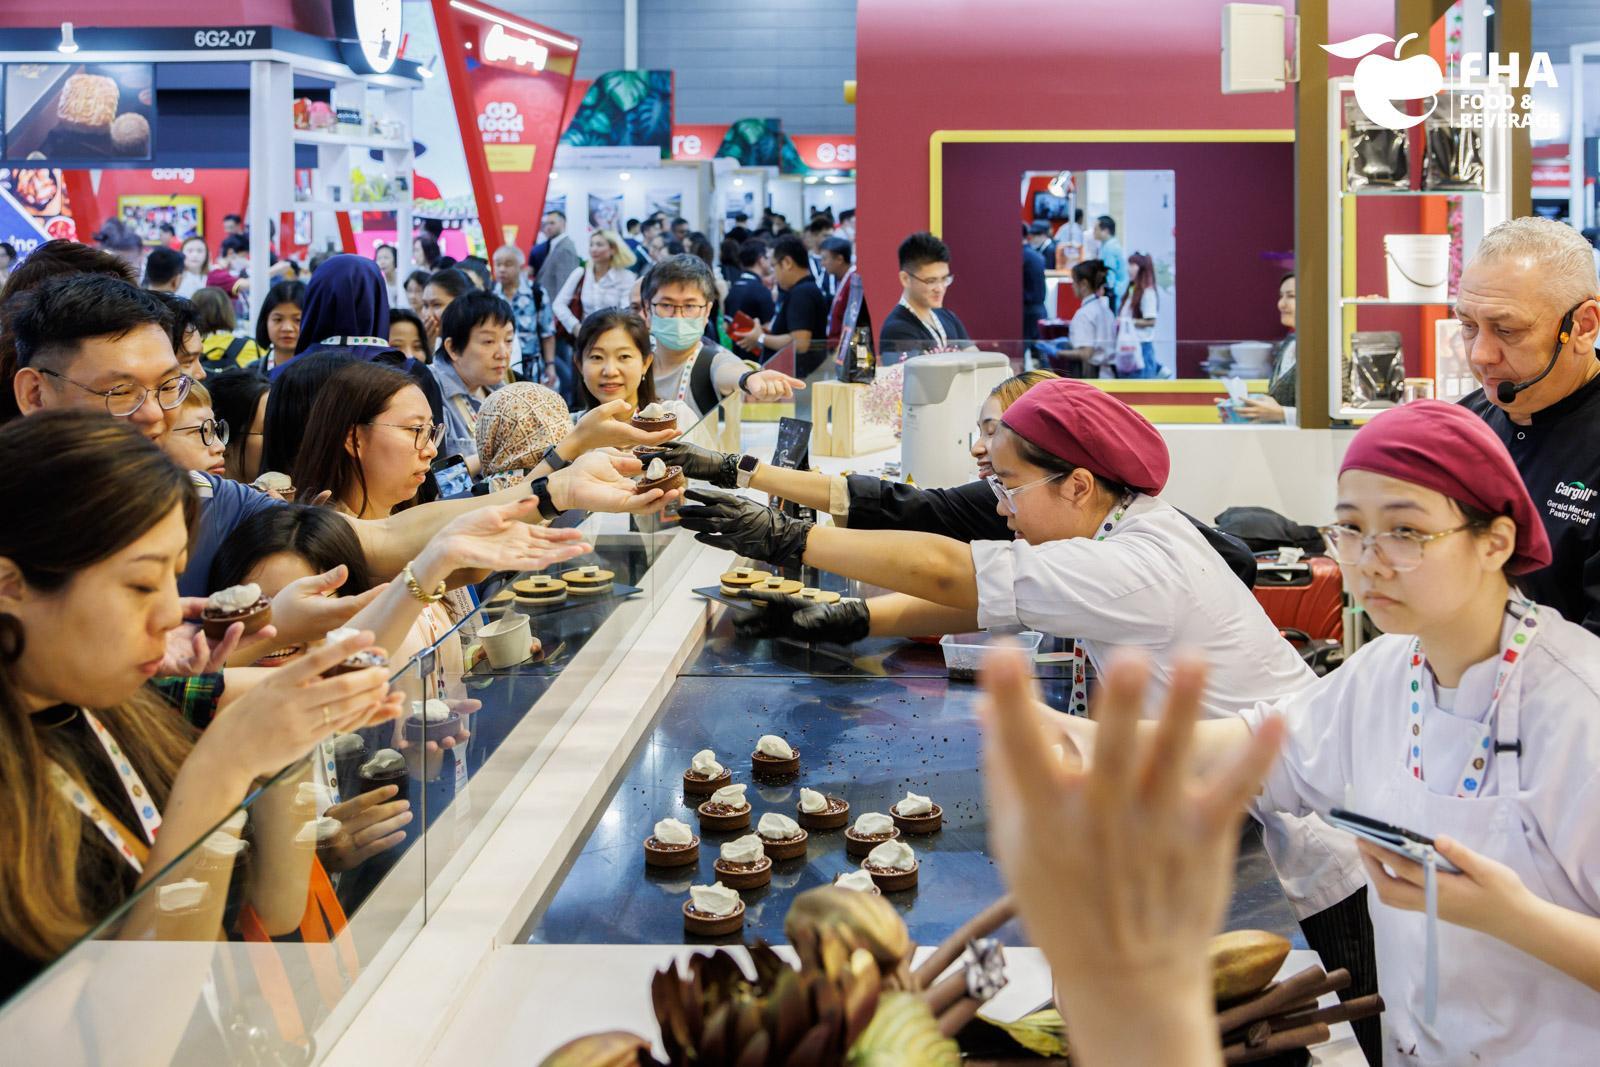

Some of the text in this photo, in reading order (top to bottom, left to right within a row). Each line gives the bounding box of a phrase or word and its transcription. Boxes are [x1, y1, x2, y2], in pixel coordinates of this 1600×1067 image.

[194, 30, 257, 48] 6G2-07
[1555, 481, 1593, 502] Cargill
[1546, 499, 1569, 511] Gerald
[1548, 508, 1591, 526] Pastry Chef
